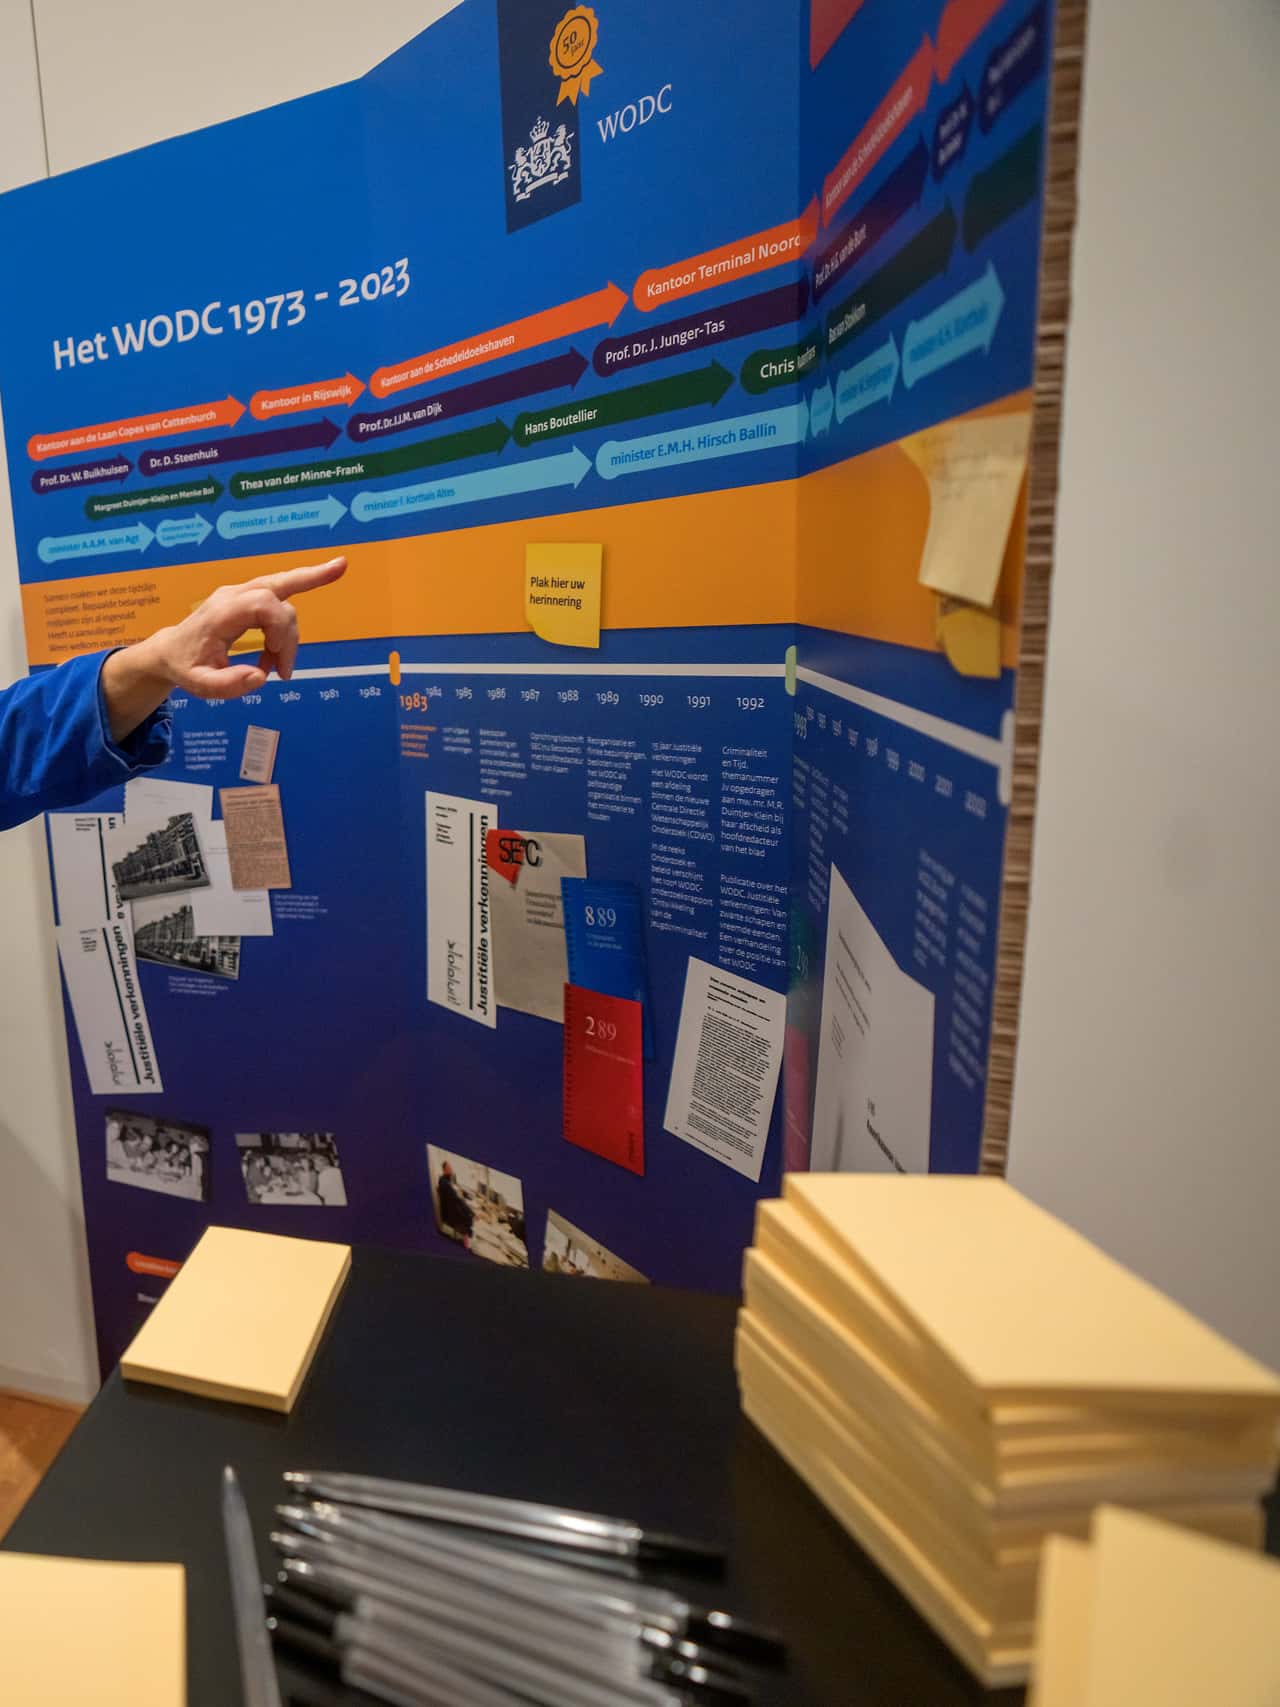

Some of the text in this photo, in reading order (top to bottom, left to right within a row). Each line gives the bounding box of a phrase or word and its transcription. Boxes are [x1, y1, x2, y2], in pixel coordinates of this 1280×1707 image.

[563, 31, 577, 55] 50
[597, 84, 672, 143] WODC
[647, 271, 696, 297] Kantoor
[698, 248, 755, 281] Terminal
[53, 332, 108, 370] Het
[112, 302, 223, 356] WODC
[228, 290, 306, 335] 1973
[339, 257, 410, 306] 2023
[606, 319, 726, 364] Prof. Dr. J. Junger-Tas
[381, 372, 409, 388] Kantoor
[424, 362, 433, 373] de
[435, 335, 515, 370] Schedeldoekshaven
[760, 358, 795, 379] Chris
[261, 385, 352, 411] Kantoor in Rijswijk
[413, 408, 426, 420] van
[427, 402, 443, 417] Dijk
[525, 408, 597, 435] Hans Boutellier
[37, 438, 69, 452] Kantoor
[87, 432, 97, 443] de
[98, 429, 118, 441] Laan
[119, 425, 144, 438] Copes
[146, 422, 161, 432] van
[162, 410, 217, 428] Cattenburch
[610, 422, 777, 466] minister E.M.H. Hirsch Ballin
[150, 447, 218, 468] Dr. D. Steenhuis
[40, 464, 129, 487] Prof. Dr. W. Buikhuisen
[240, 463, 364, 490] Thea van der Minne-Frank
[230, 515, 267, 529] minister
[277, 512, 289, 522] de
[291, 508, 320, 521] Ruiter
[530, 576, 585, 590] Plak hier uw
[530, 593, 582, 610] herinnering
[242, 695, 261, 705] 1979
[280, 691, 301, 703] 1980
[319, 689, 340, 700] 1981
[359, 686, 382, 698] 1982
[400, 692, 428, 711] 1983
[456, 687, 472, 700] 1985
[488, 688, 506, 701] 1986
[521, 689, 540, 701] 1987
[558, 689, 579, 703] 1988
[596, 691, 619, 704] 1989
[639, 694, 664, 707] 1990
[687, 695, 711, 708] 1991
[736, 697, 765, 710] 1992
[722, 746, 768, 758] Criminaliteit
[664, 770, 687, 780] WODC
[730, 784, 775, 797] opgedragen
[112, 925, 142, 1021] verkenningen
[477, 939, 489, 1016] Justitiële
[133, 1021, 156, 1084] Justitiële
